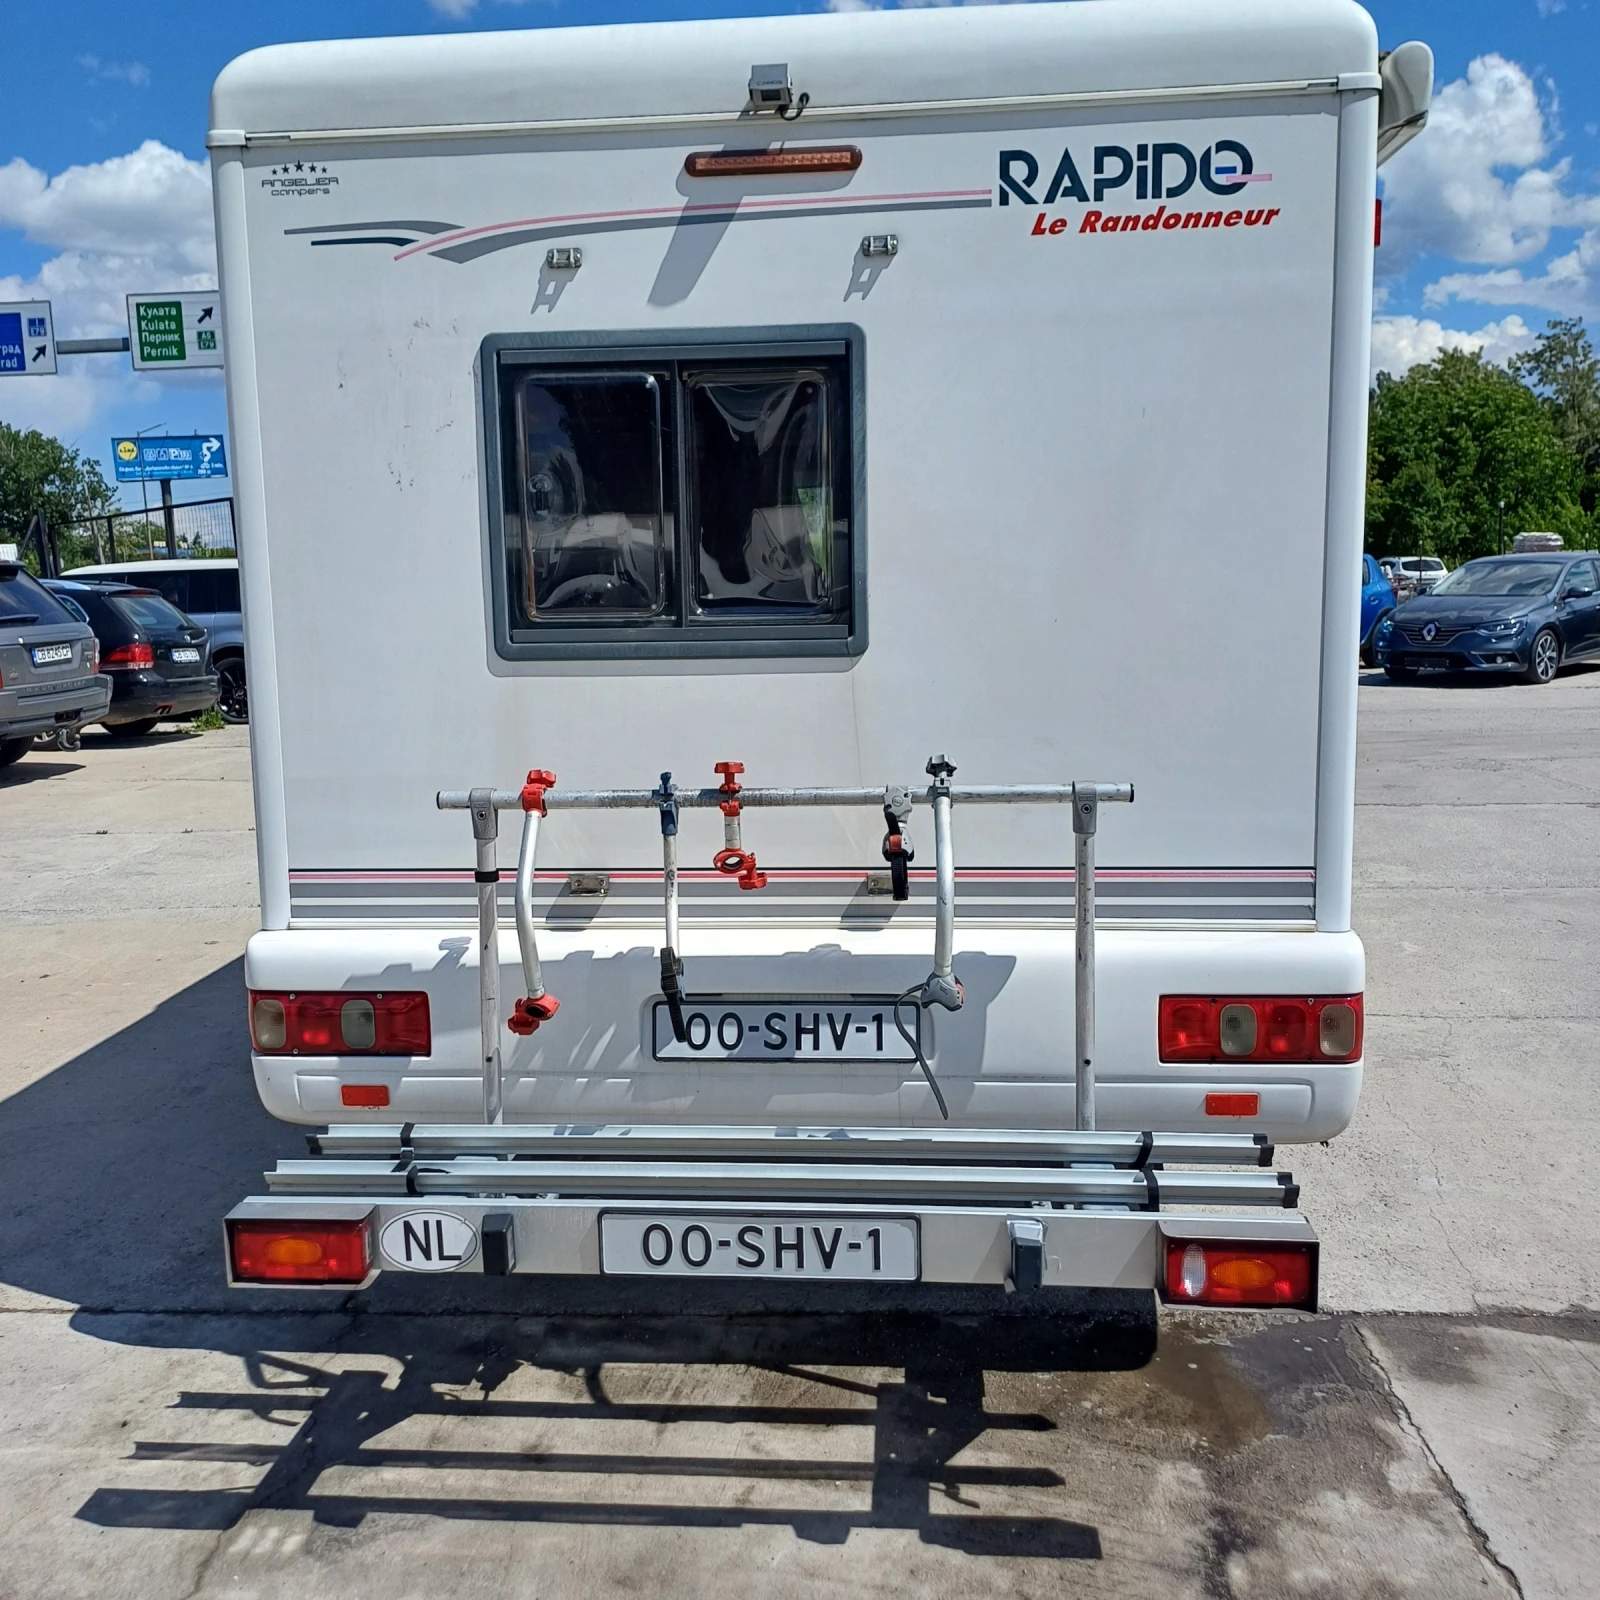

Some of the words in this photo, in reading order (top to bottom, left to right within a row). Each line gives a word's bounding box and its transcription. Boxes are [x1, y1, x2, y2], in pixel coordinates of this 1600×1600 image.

[271, 188, 330, 197] campers
[1031, 212, 1068, 236] Le
[1078, 205, 1281, 234] Randonneur
[140, 304, 177, 318] Кулата
[141, 319, 176, 331] Kulata
[142, 331, 180, 344] Перник
[143, 345, 179, 357] Pernik
[686, 1012, 883, 1051] 00-SHV-1
[403, 1219, 462, 1262] NL
[642, 1223, 882, 1271] 00-SHV-1
